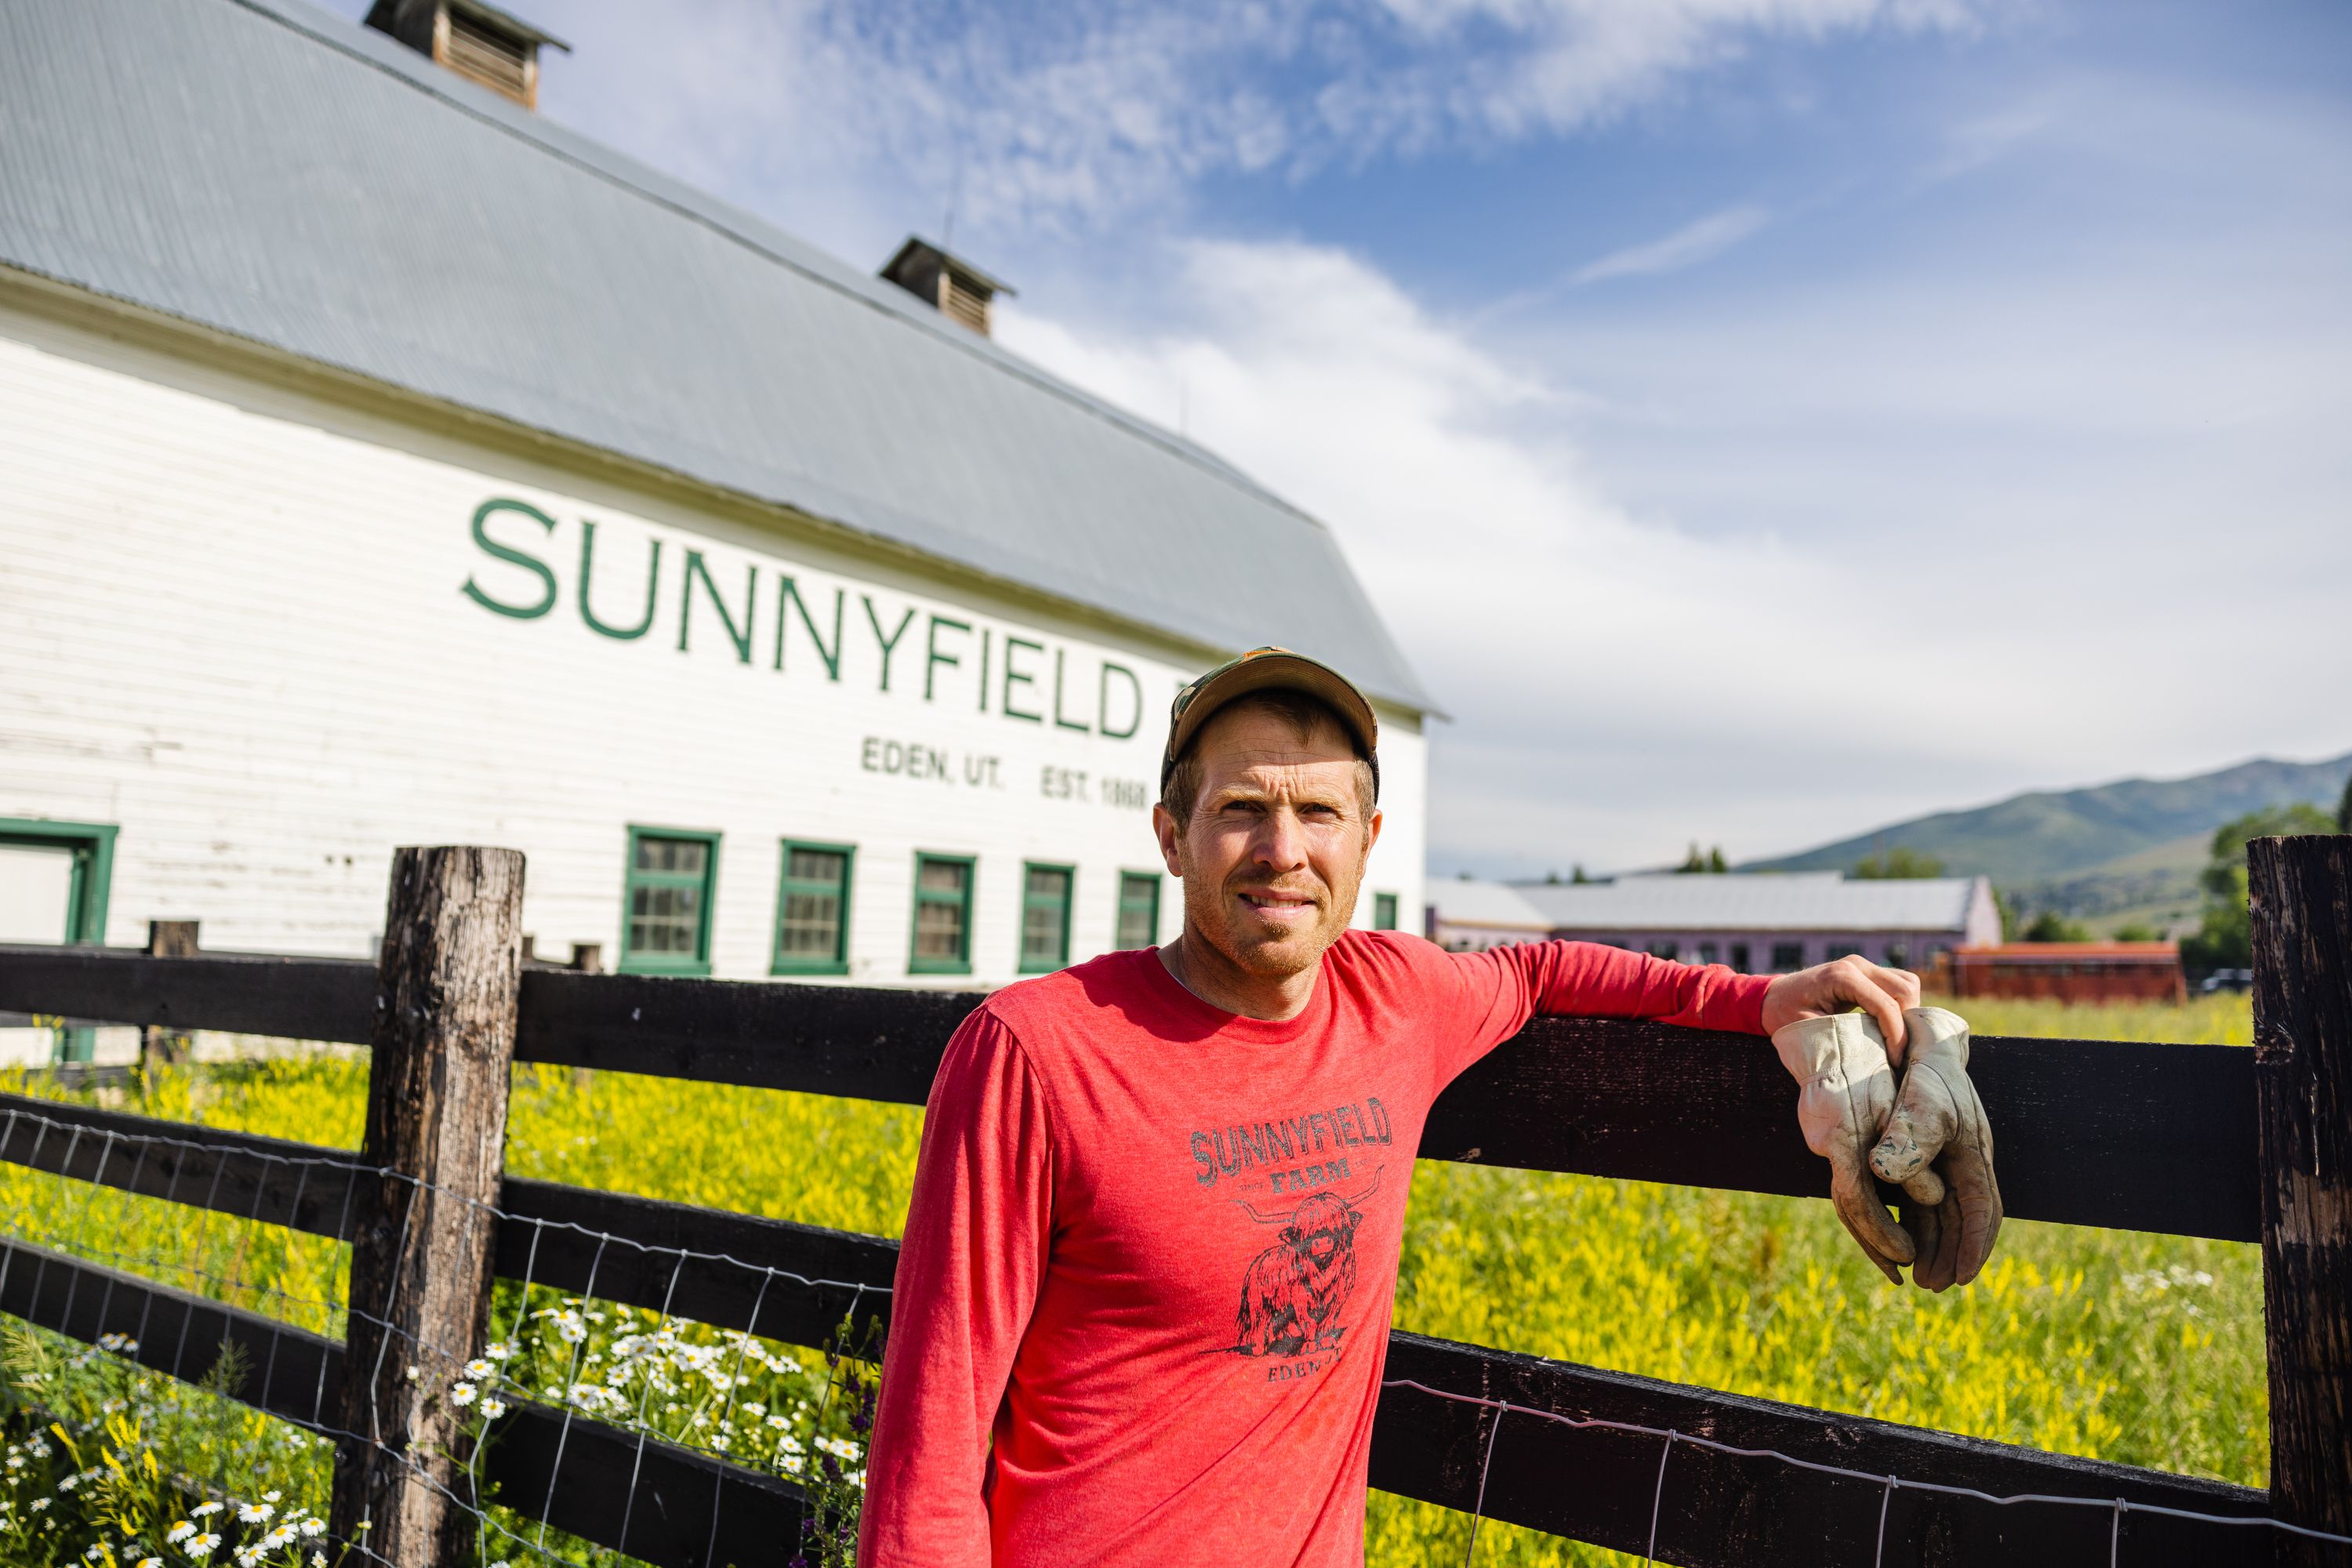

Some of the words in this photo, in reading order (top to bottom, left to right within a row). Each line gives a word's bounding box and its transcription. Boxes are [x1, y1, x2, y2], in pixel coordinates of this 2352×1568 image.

[459, 497, 1143, 740] SUNNYFIELD
[861, 735, 956, 786] EDEN,
[1191, 1097, 1392, 1189] SUNNYFIELD
[1269, 1158, 1352, 1194] FARM
